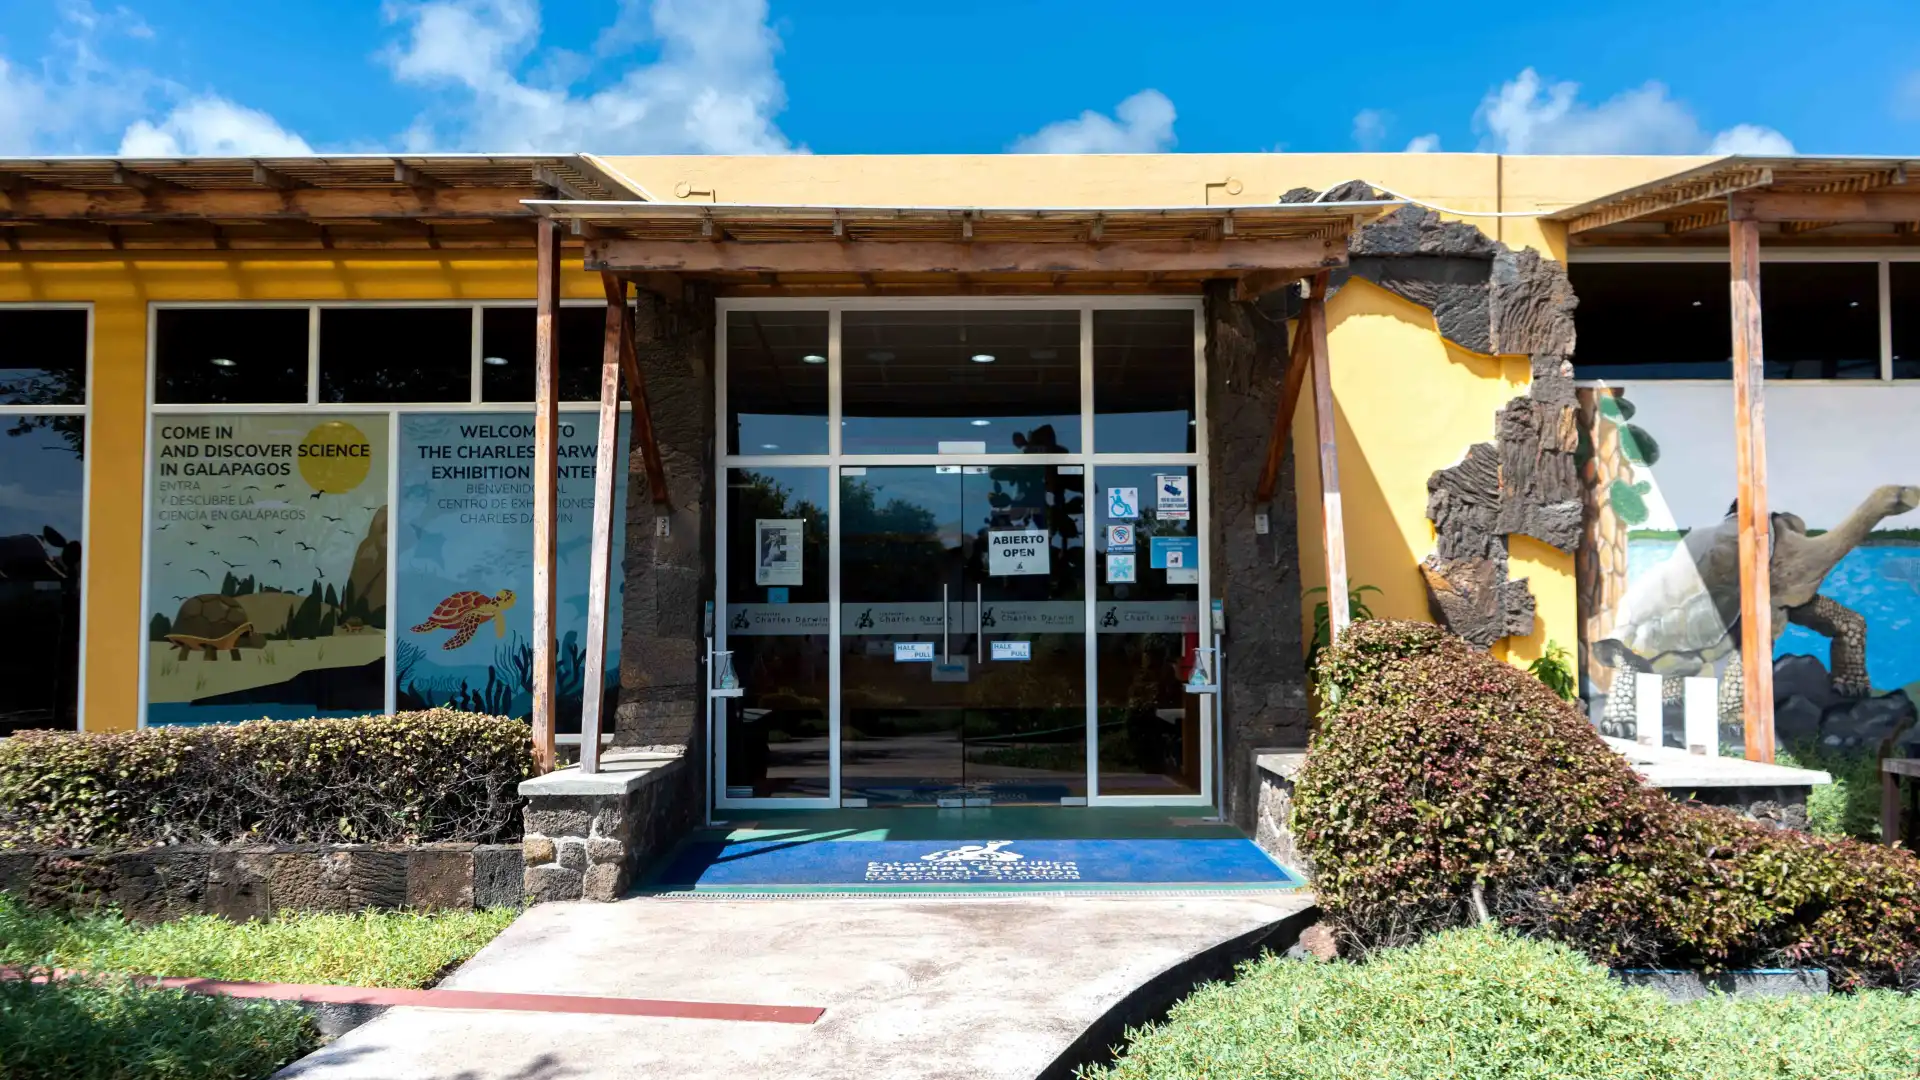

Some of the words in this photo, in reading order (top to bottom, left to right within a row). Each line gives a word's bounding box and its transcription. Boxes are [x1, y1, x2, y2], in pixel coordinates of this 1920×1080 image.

[161, 426, 210, 439] COME
[216, 426, 233, 439] IN
[460, 425, 536, 438] WELCOM
[161, 445, 199, 458] AND
[205, 444, 292, 458] DISCOVER
[297, 444, 370, 458] SCIENCE
[418, 446, 452, 458] THE
[457, 446, 536, 458] CHARLES
[160, 463, 178, 476] IN
[184, 462, 291, 476] GALAPAGOS
[432, 466, 530, 479] EXHIBITION
[160, 481, 201, 491] ENTRA
[170, 496, 235, 506] DESCUBRE
[238, 496, 254, 506] LA
[438, 500, 487, 508] CENTRO
[491, 500, 507, 508] DE
[158, 510, 207, 521] CIENCIA
[212, 510, 227, 520] EN
[460, 514, 516, 524] CHARLES
[993, 535, 1044, 545] ABIERTO
[1003, 548, 1035, 558] OPEN
